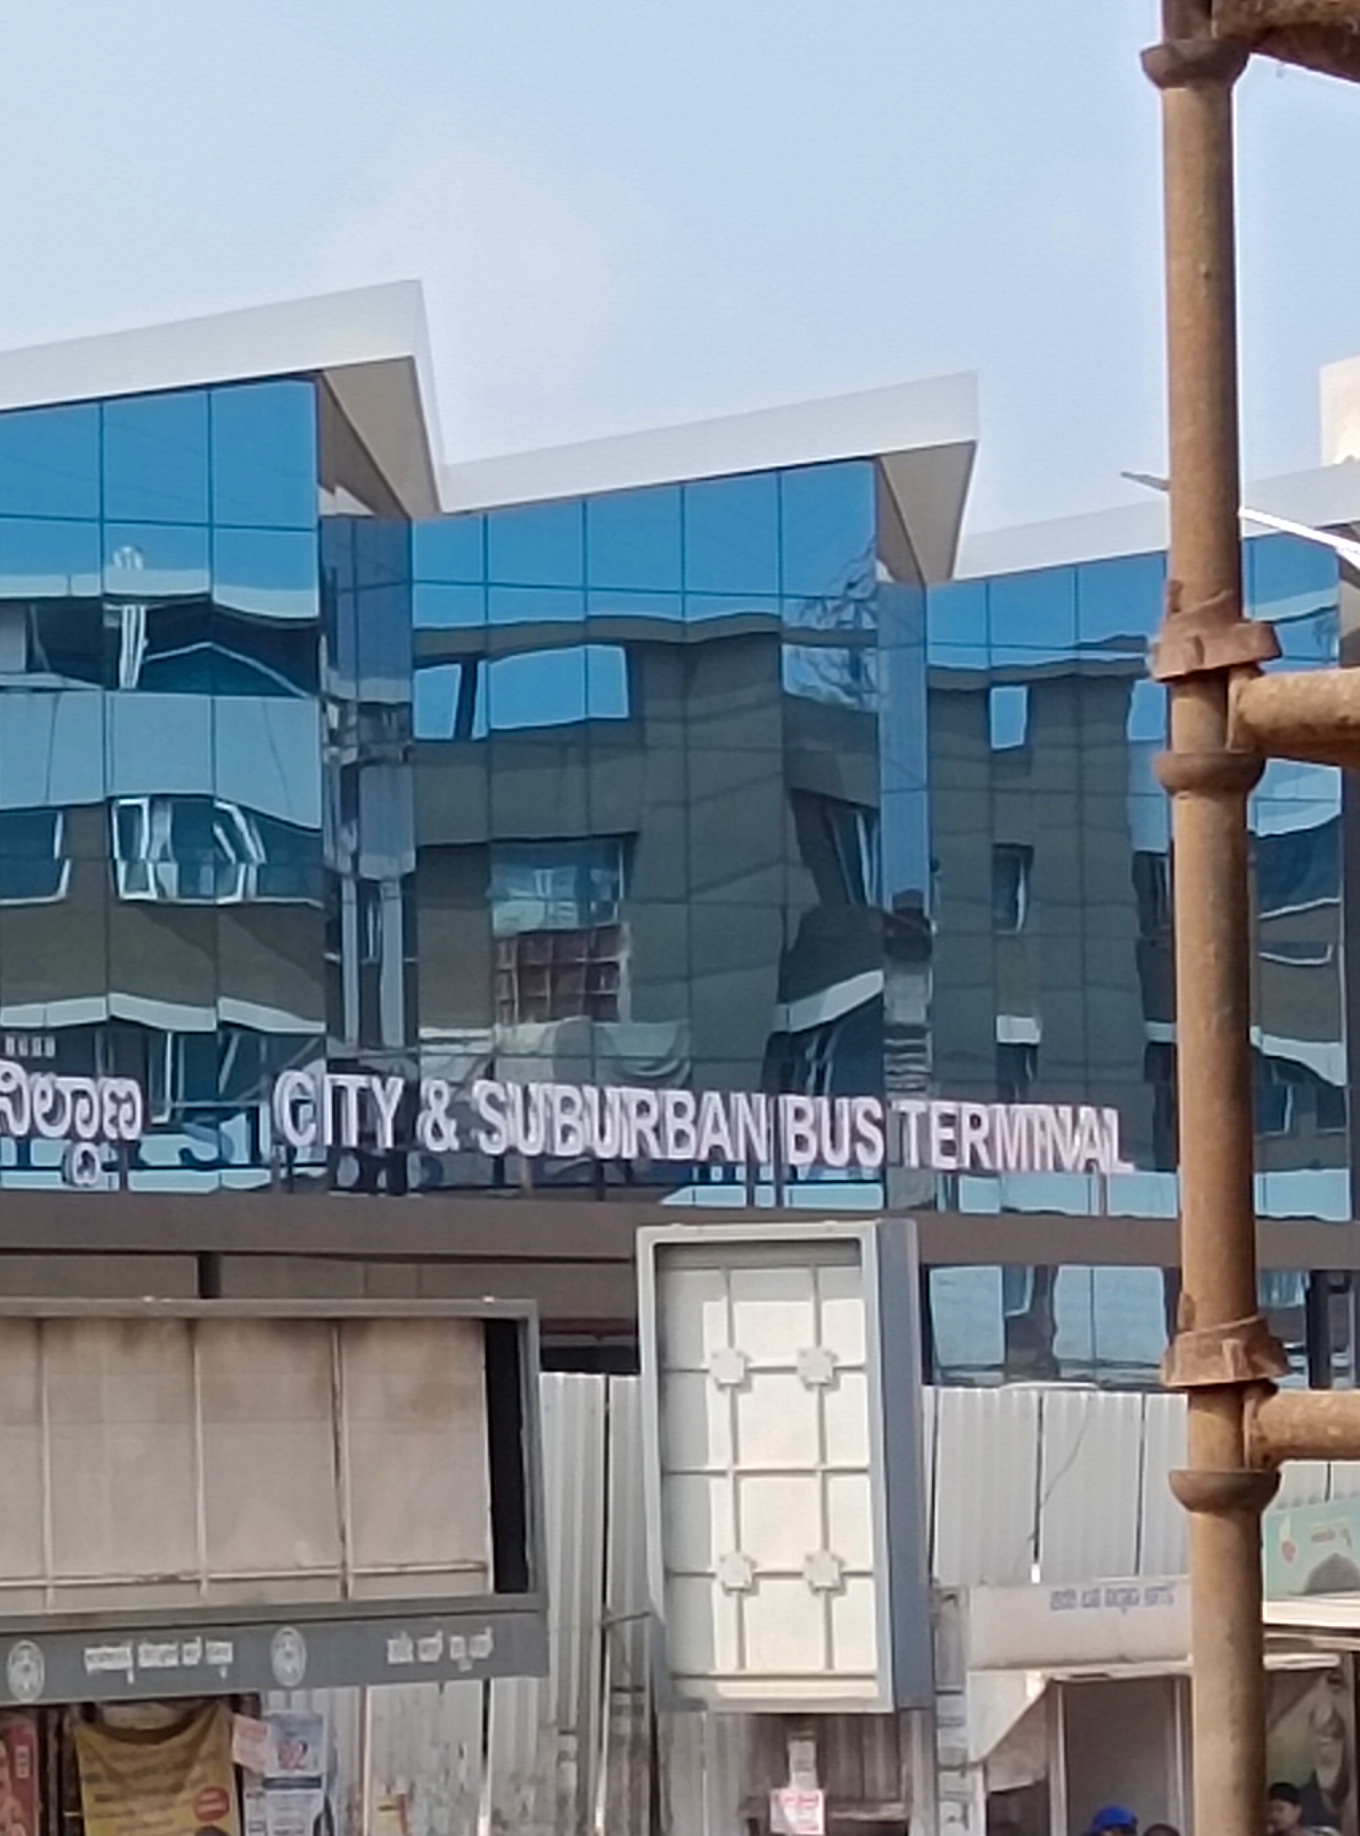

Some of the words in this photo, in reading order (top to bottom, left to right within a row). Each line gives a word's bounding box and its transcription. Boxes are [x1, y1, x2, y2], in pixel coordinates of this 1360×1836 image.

[273, 1069, 405, 1149] CITY
[417, 1078, 460, 1152] &
[471, 1078, 772, 1162] SUBURBAN
[781, 1093, 885, 1168] BUS
[892, 1098, 1136, 1174] TERMINAL
